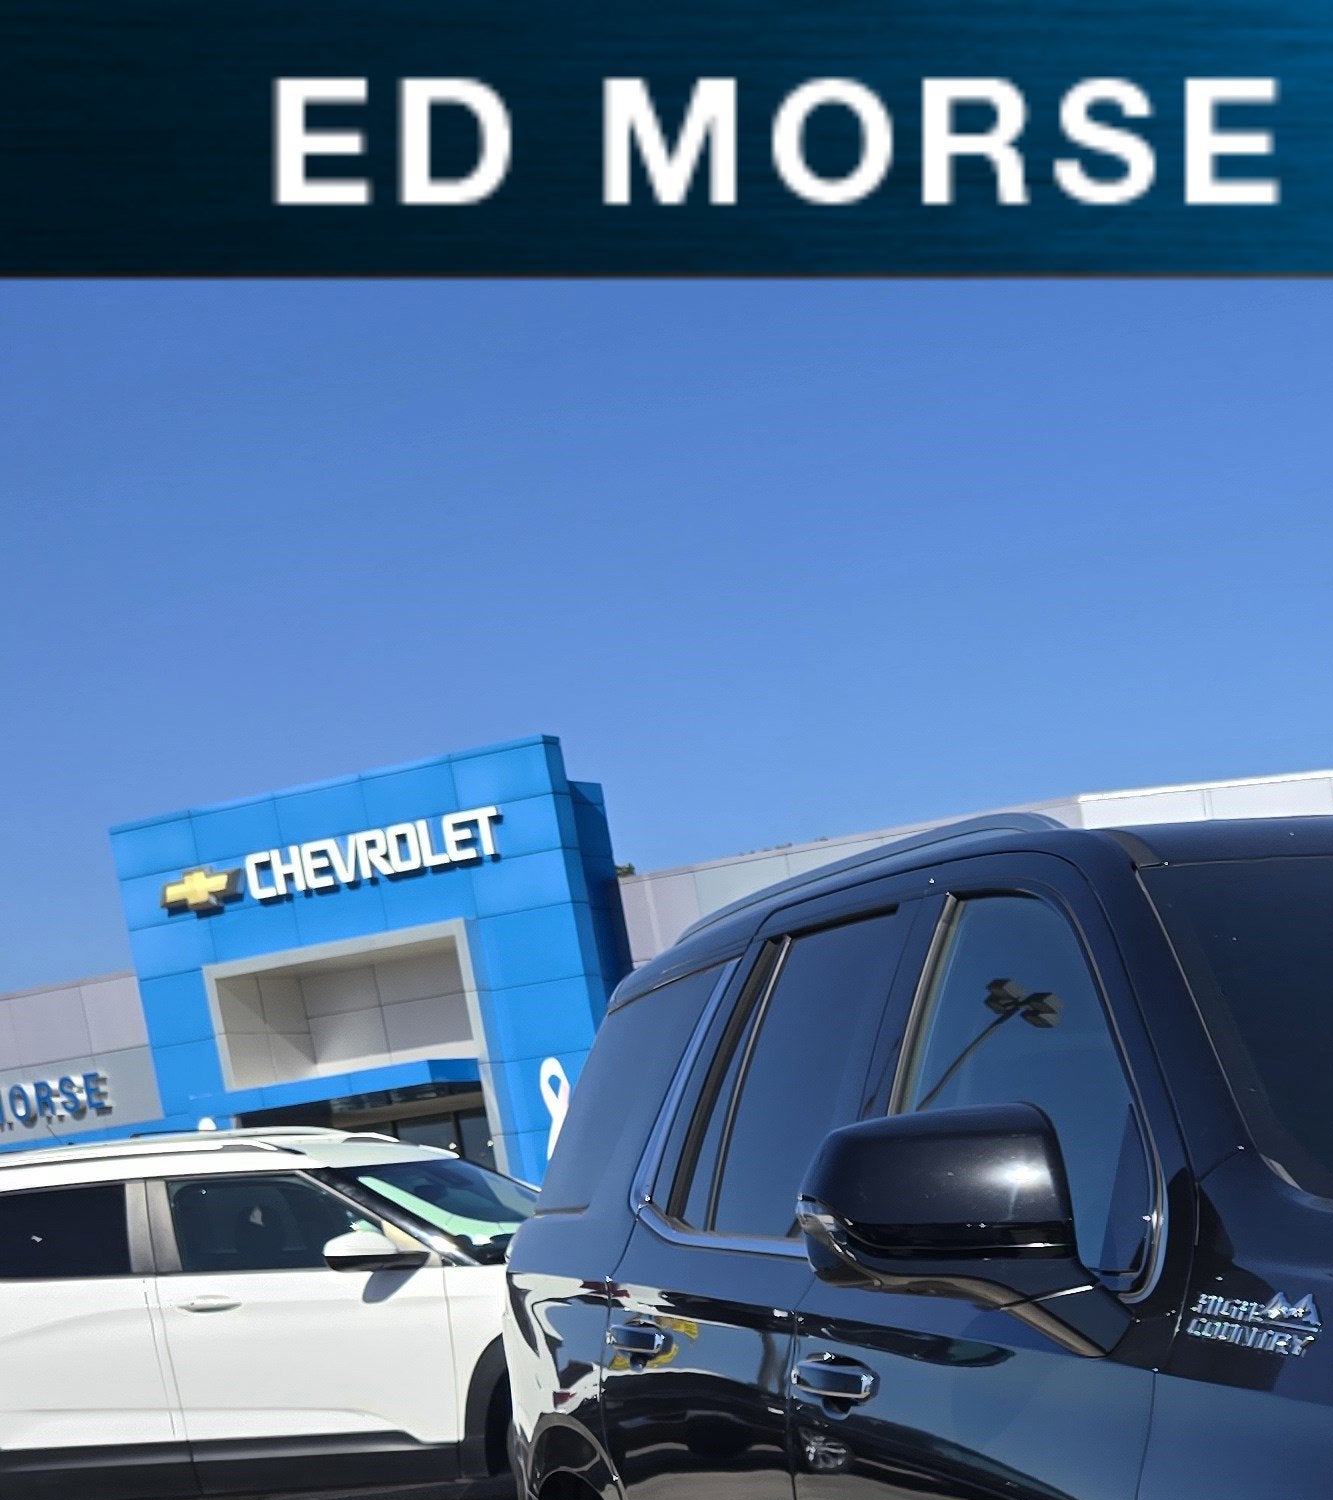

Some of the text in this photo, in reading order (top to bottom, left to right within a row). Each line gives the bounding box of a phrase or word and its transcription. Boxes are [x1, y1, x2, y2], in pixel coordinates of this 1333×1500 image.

[245, 806, 498, 900] CHEVROLET
[0, 1072, 106, 1125] ORSE
[1190, 1293, 1265, 1322] HIGH
[1187, 1318, 1315, 1356] COUNTRY
